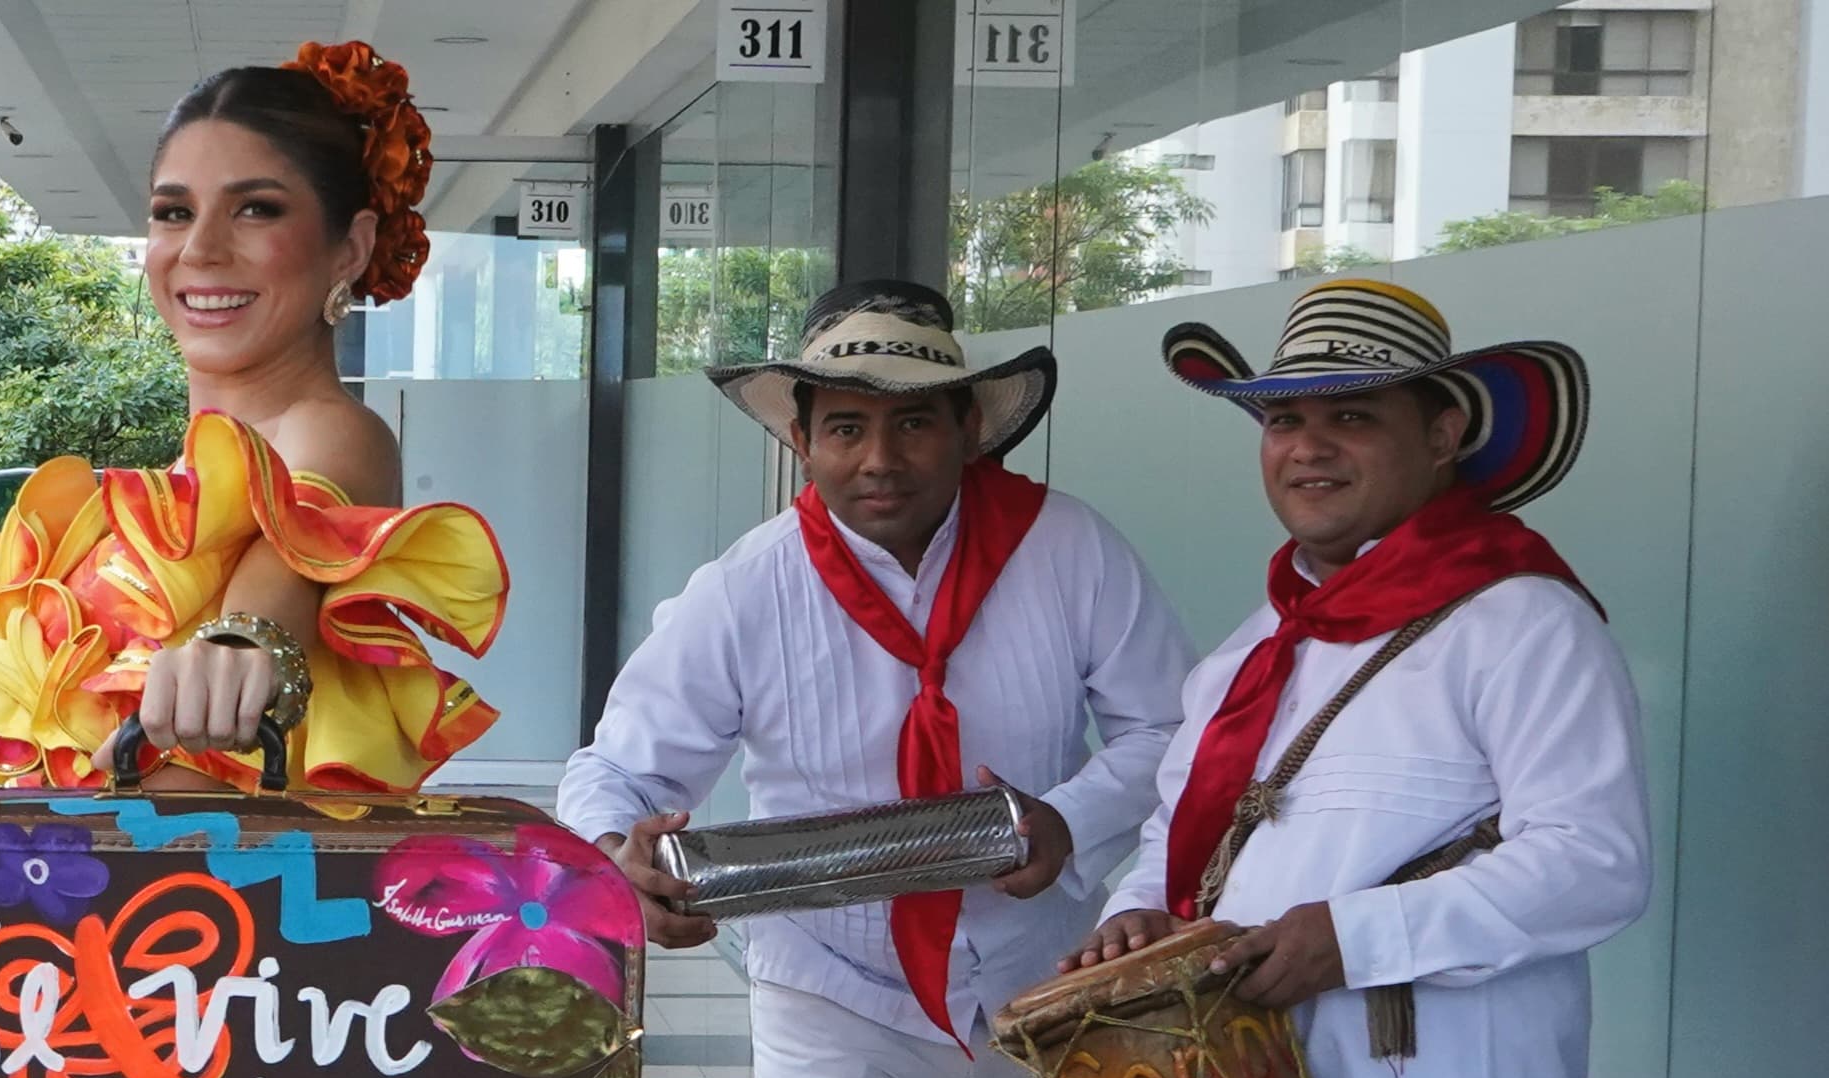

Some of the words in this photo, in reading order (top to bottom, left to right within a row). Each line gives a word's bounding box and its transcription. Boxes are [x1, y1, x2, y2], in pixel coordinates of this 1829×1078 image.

[739, 19, 802, 59] 311
[531, 199, 569, 223] 310
[128, 957, 432, 1076] vive
